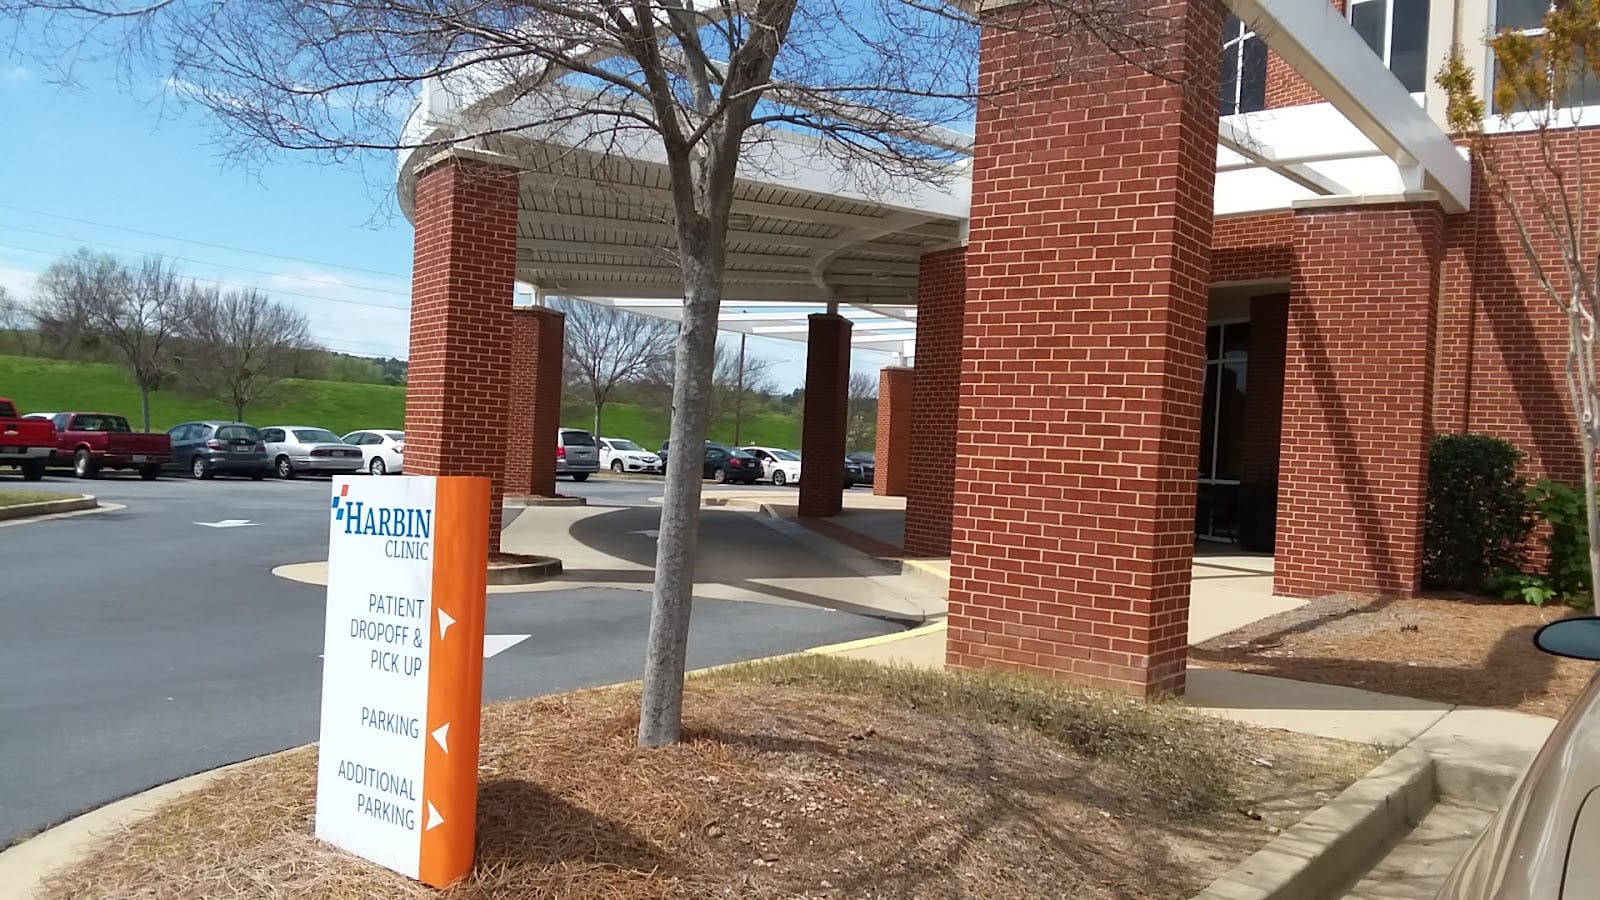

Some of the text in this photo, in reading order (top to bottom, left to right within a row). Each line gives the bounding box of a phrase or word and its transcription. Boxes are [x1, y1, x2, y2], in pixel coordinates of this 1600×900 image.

[344, 501, 432, 538] HARBIN
[385, 539, 429, 561] CLINIC
[368, 593, 425, 619] PATIENT
[350, 618, 423, 649] DROPOFF &
[370, 649, 422, 677] PICK UP
[361, 706, 419, 739] PARKING
[338, 759, 416, 802] ADDITIONAL
[357, 793, 415, 831] PARKING
